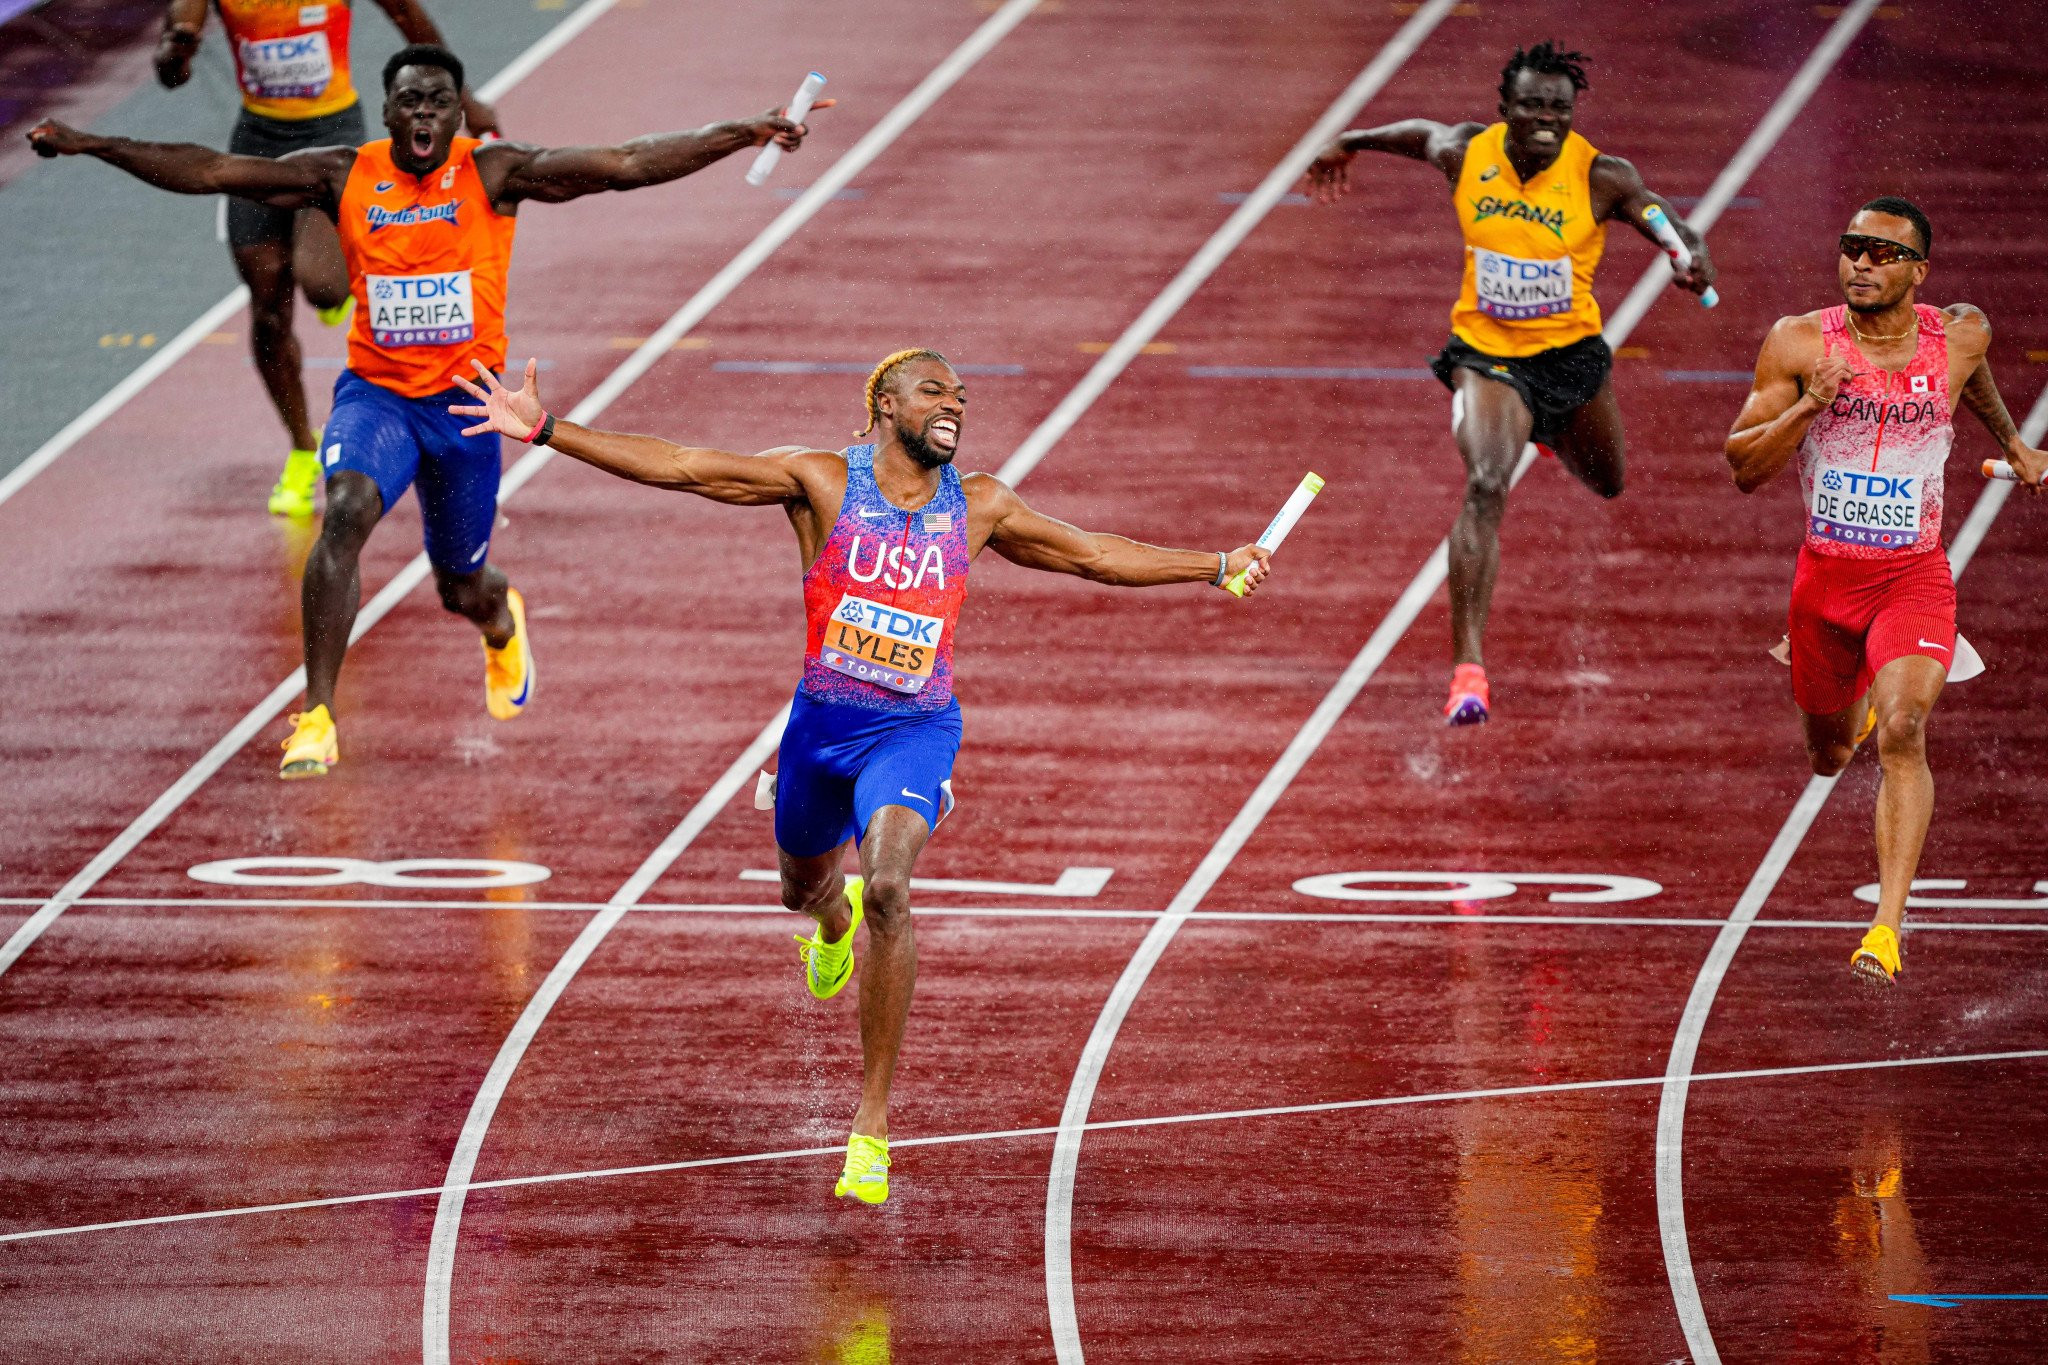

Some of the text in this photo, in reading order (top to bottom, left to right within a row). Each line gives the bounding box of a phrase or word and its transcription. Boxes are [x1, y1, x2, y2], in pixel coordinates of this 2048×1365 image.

[260, 37, 319, 61] TDK
[1476, 196, 1564, 227] GHANA
[1501, 257, 1562, 280] TDK
[393, 275, 461, 299] TDK
[1481, 277, 1567, 301] SAMINU
[376, 302, 465, 326] AFRIFA
[1831, 394, 1935, 424] CANADA
[1843, 472, 1914, 499] TDK
[1818, 494, 1915, 528] DE GRASSE
[848, 535, 945, 590] USA
[866, 604, 937, 644] TDK
[837, 626, 924, 671] LYLES
[186, 856, 553, 889] 8
